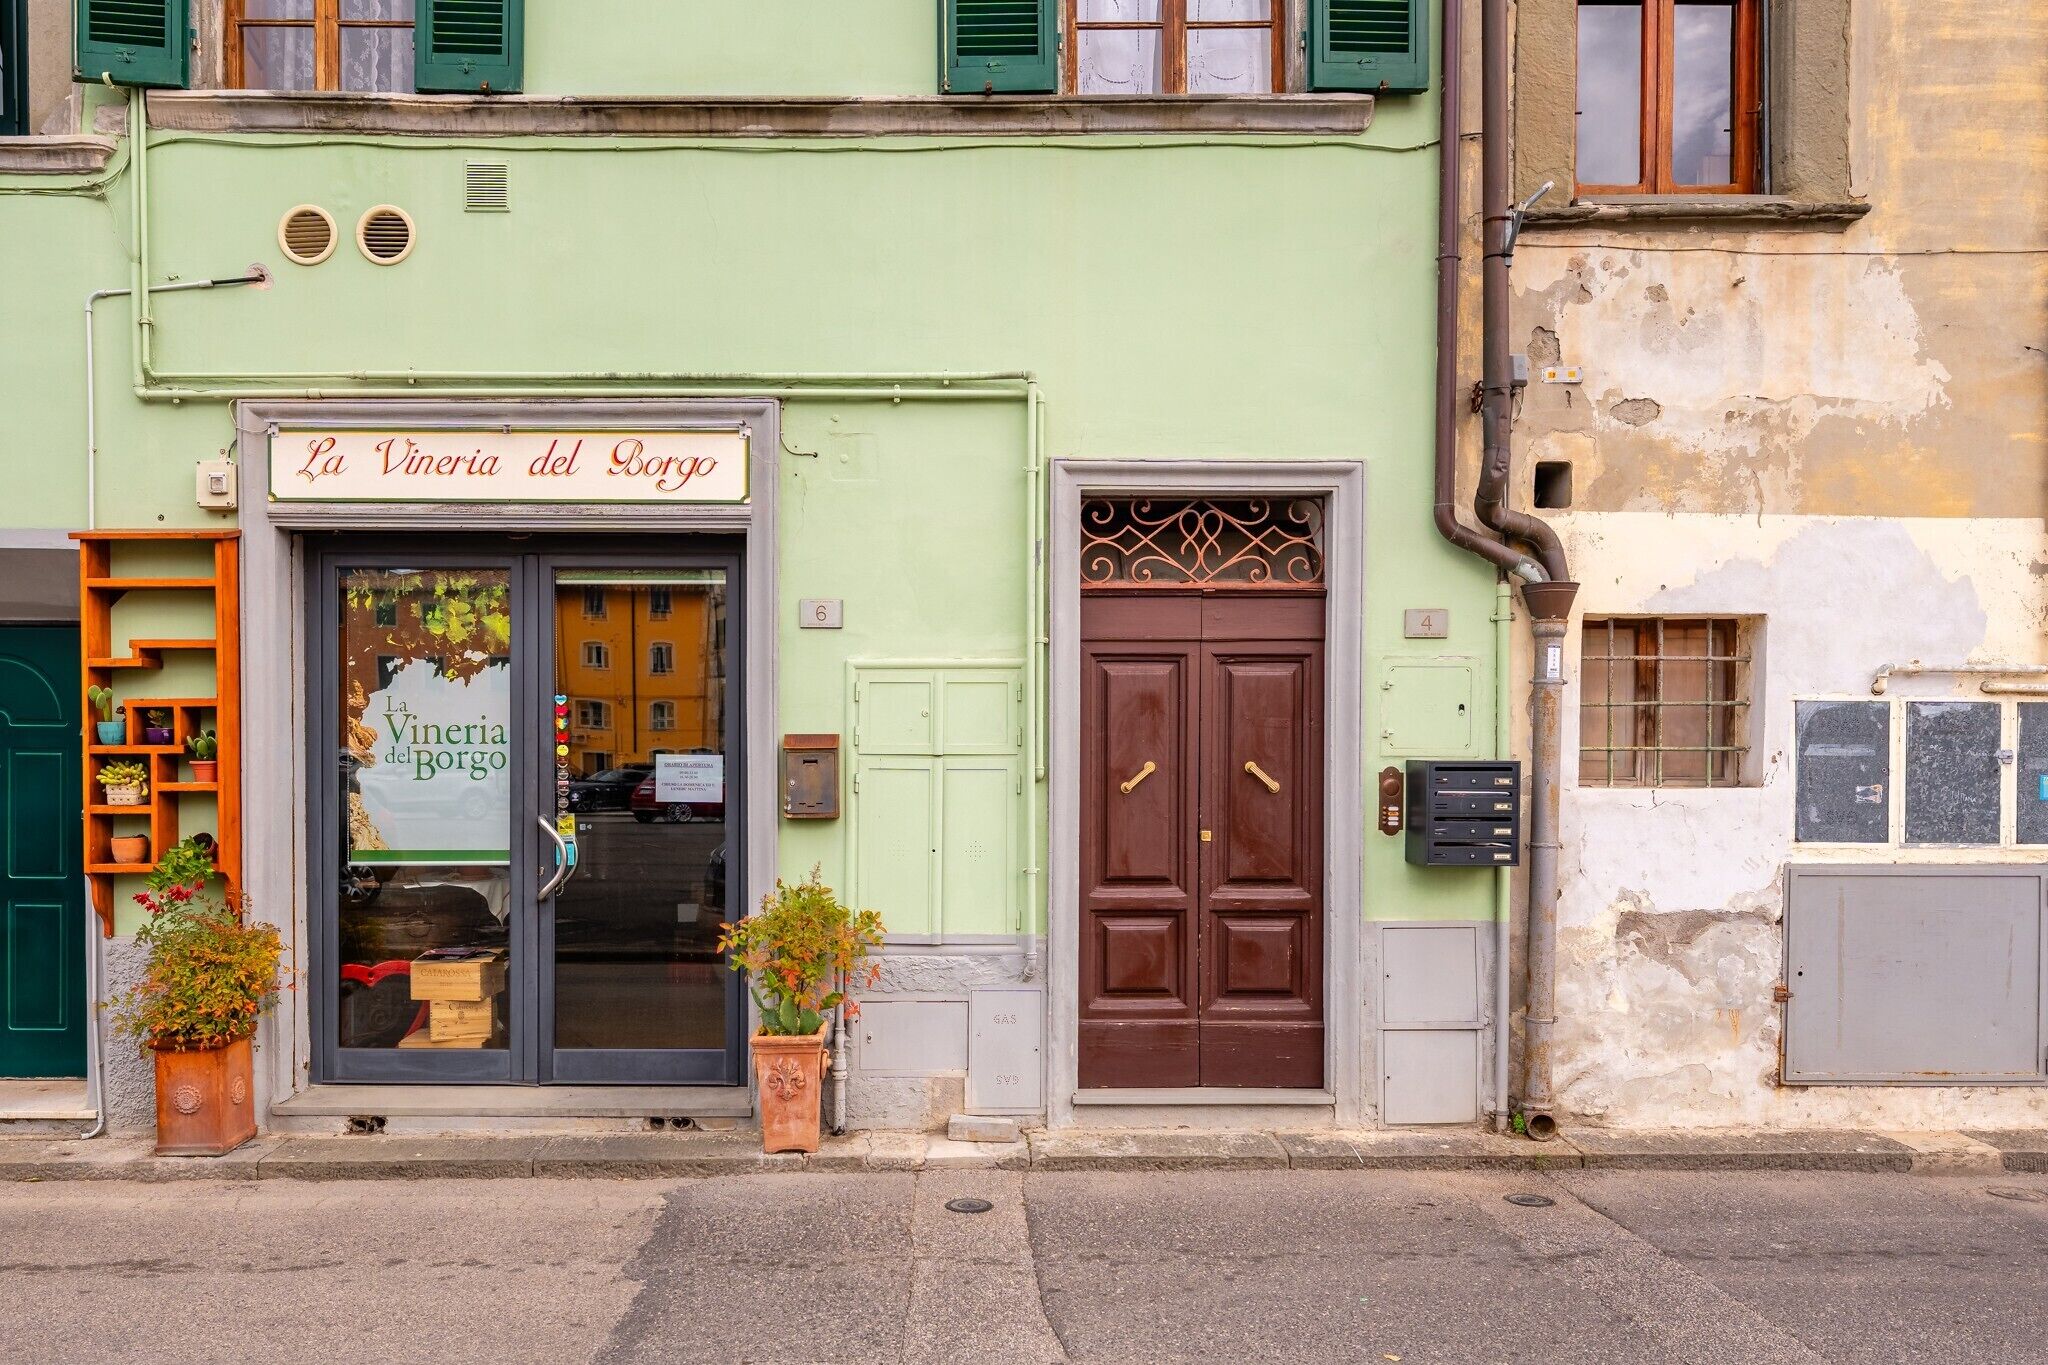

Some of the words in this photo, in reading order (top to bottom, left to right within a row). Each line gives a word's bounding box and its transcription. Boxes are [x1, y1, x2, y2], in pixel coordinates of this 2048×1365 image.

[296, 436, 349, 484] La
[375, 437, 503, 477] Vineria
[528, 439, 581, 477] del
[606, 438, 720, 492] Borgo
[816, 605, 827, 621] 6
[1421, 615, 1432, 631] 4
[385, 696, 408, 712] La
[382, 713, 507, 745] Vineria
[384, 746, 412, 764] del
[413, 750, 507, 781] Borgo
[993, 1014, 1017, 1025] GAS
